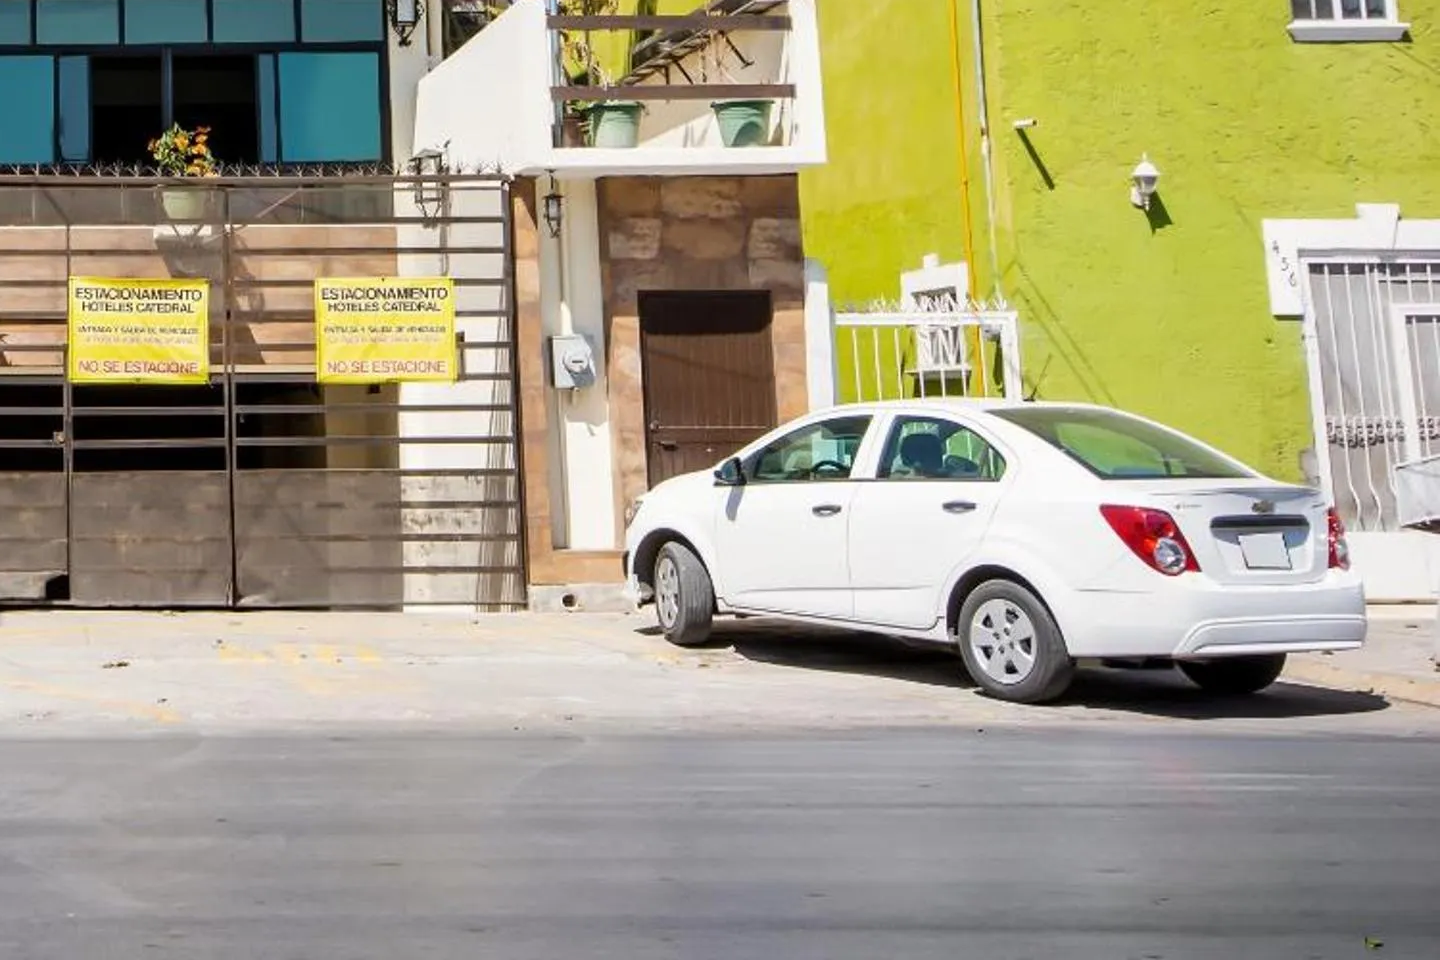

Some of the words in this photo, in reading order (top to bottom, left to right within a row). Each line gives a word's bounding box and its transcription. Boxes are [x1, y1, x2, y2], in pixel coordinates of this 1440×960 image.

[75, 287, 202, 302] ESTACIONAMIENTO
[321, 287, 448, 301] ESTACIONAMIENTO
[82, 301, 134, 313] HOTELES
[136, 302, 195, 314] CATEDRAL
[327, 301, 379, 312] HOTELES
[381, 301, 441, 312] CATEDRAL
[79, 360, 99, 373] NO
[103, 360, 122, 373] SE
[124, 360, 199, 374] ESTACIONE
[327, 360, 348, 373] NO
[351, 360, 369, 373] SE
[371, 360, 446, 373] ESTACIONE
